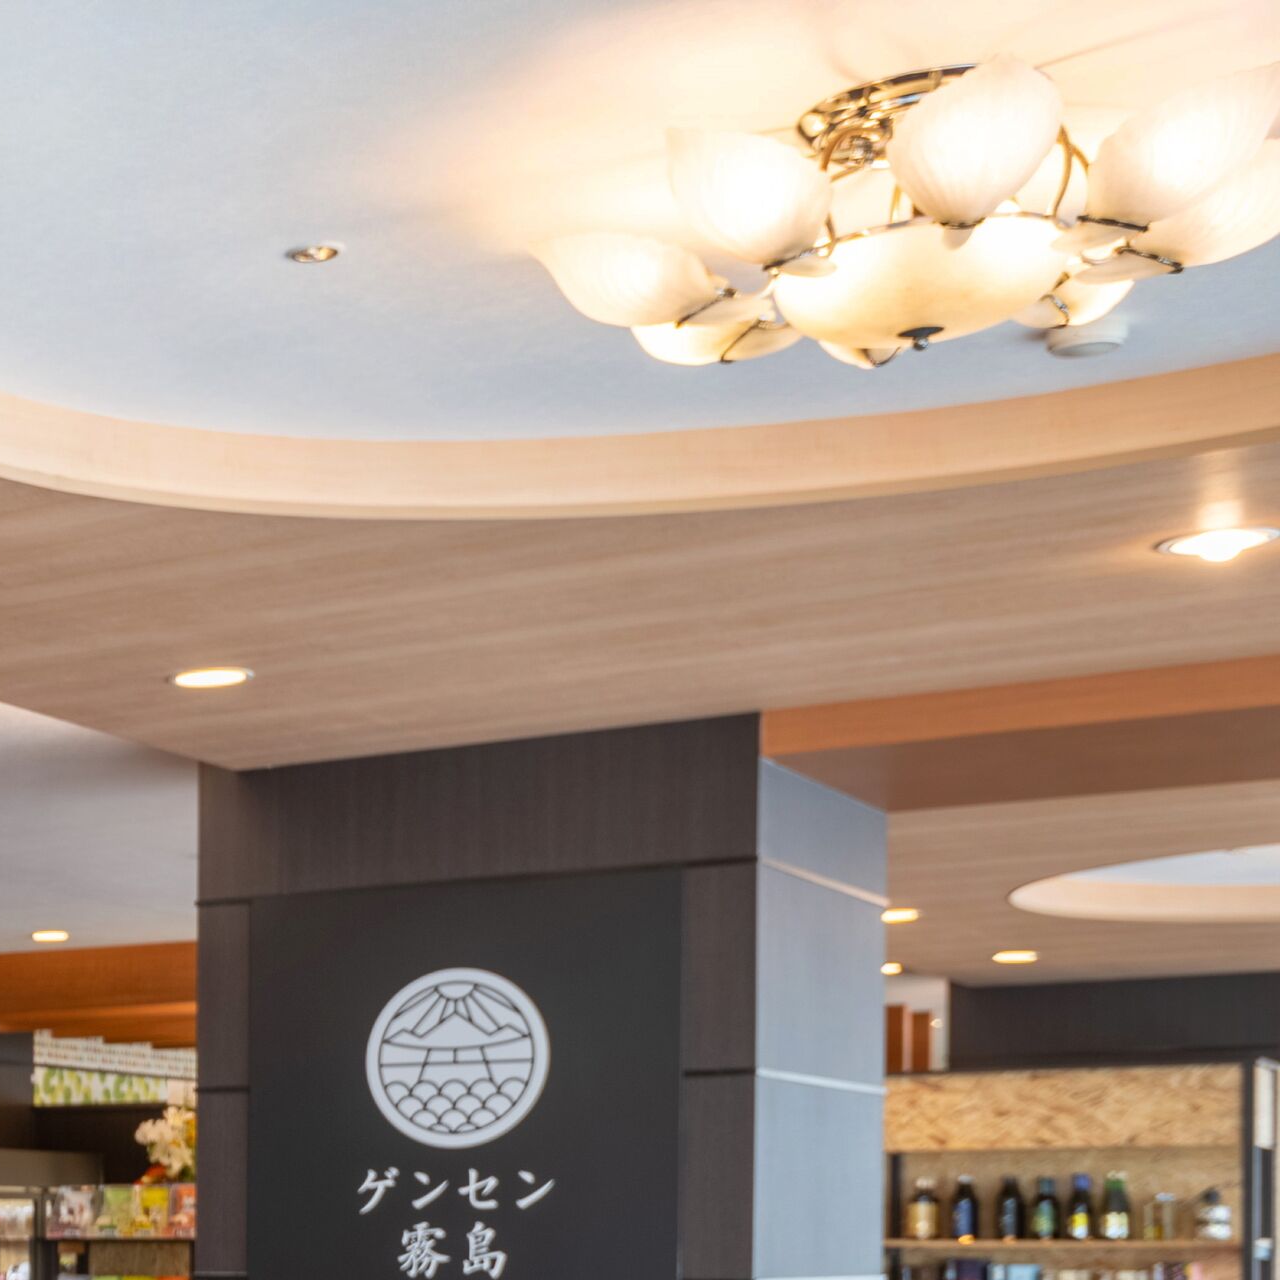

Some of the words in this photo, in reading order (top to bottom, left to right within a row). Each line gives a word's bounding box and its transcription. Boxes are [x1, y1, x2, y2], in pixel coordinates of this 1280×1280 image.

[356, 1166, 556, 1216] ゲンセン
[396, 1220, 509, 1280] 霧島
